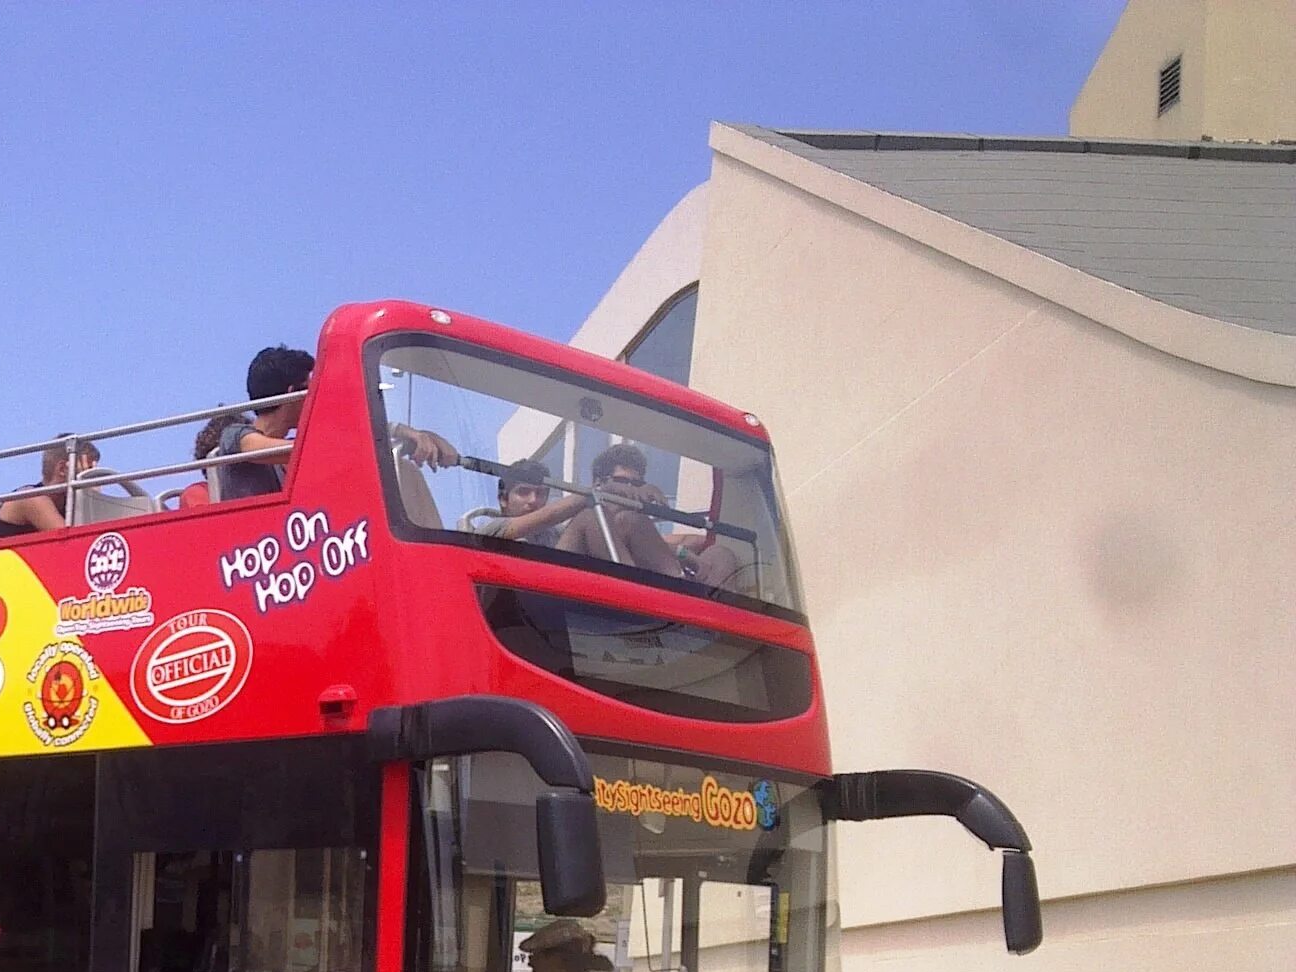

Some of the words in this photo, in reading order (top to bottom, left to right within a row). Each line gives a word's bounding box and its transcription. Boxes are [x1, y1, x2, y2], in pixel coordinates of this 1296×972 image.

[286, 511, 329, 551] On
[322, 520, 368, 576] Off
[166, 612, 208, 634] TOUR
[151, 647, 231, 685] OFFICIAL
[170, 706, 185, 719] OF
[187, 695, 220, 717] GOZO
[593, 775, 702, 822] itySightseeing
[702, 775, 757, 830] Gozo
